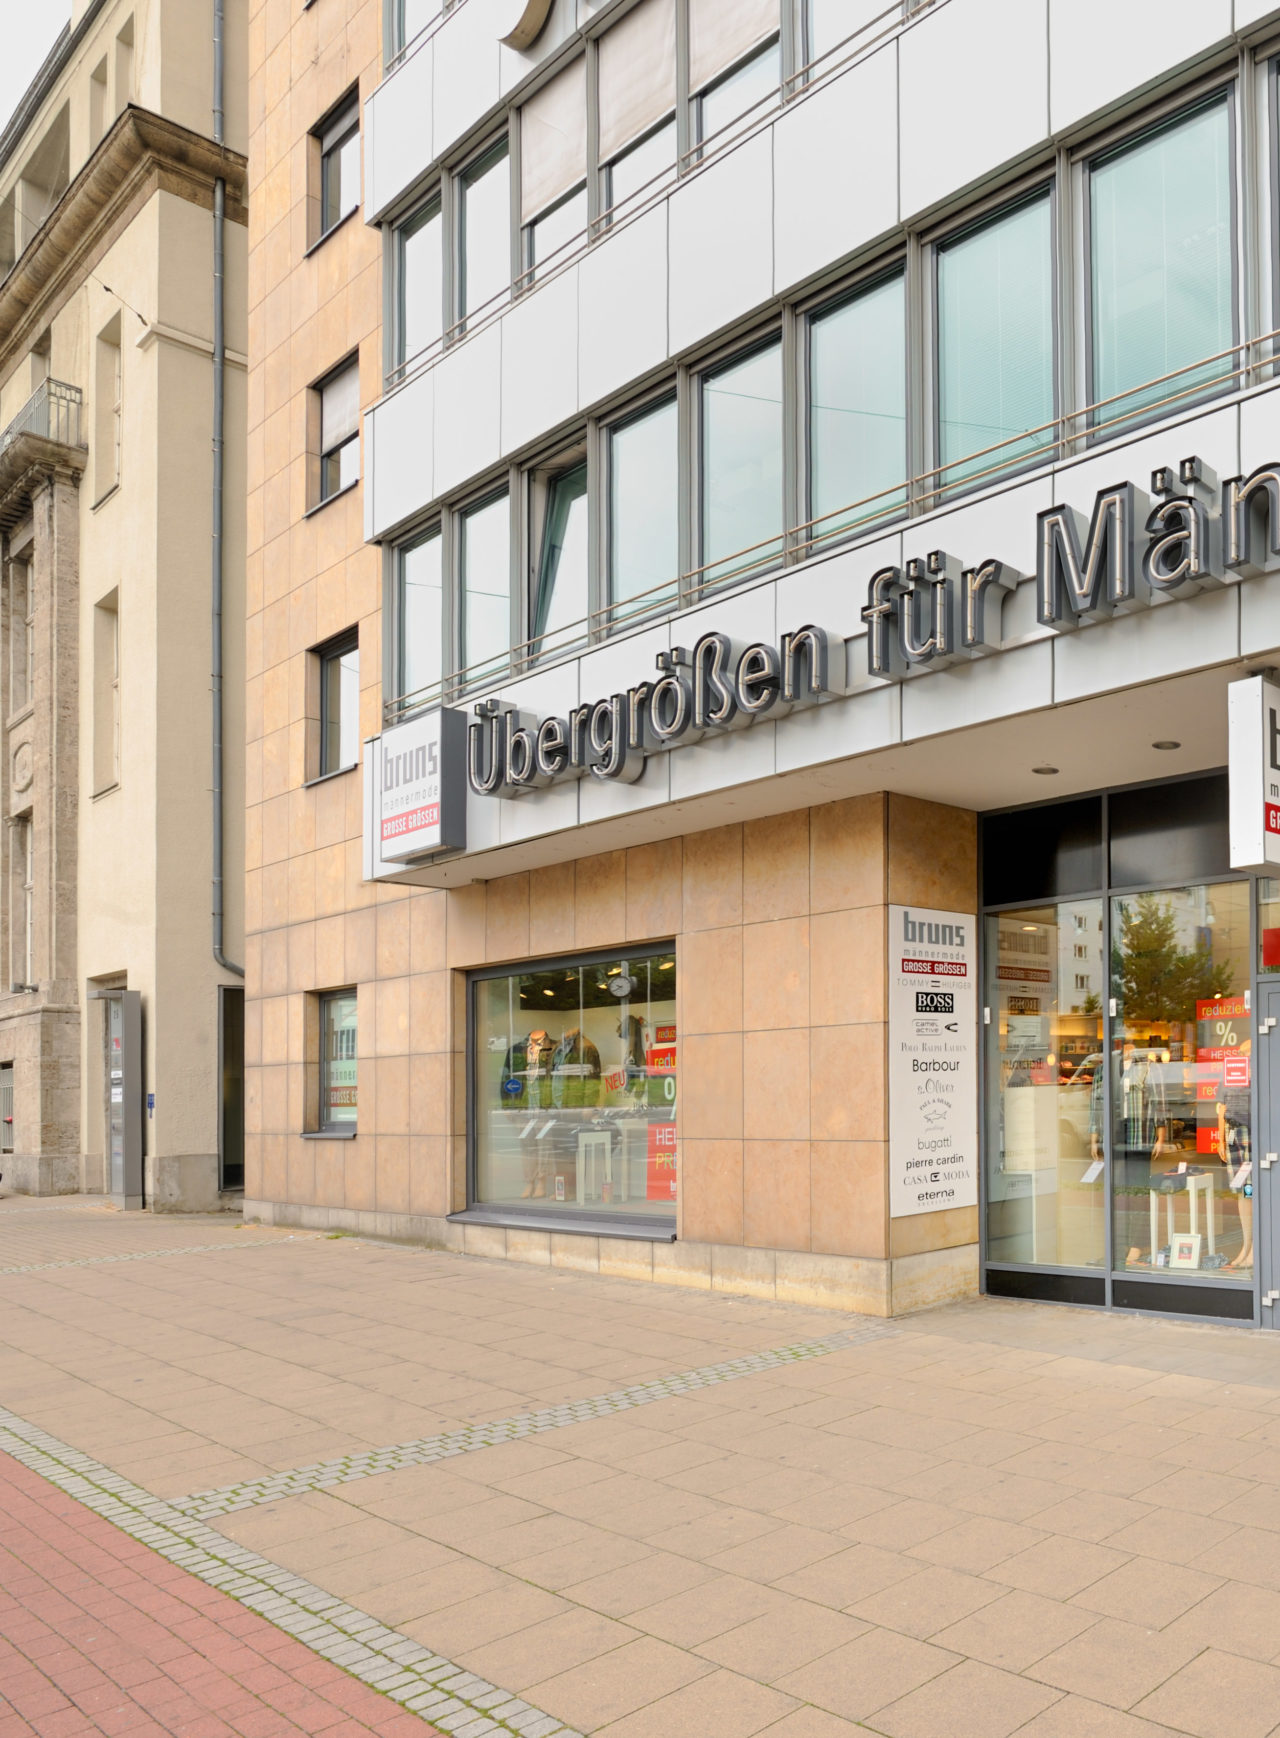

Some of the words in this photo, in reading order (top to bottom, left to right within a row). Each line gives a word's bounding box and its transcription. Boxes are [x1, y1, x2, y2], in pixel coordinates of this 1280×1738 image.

[467, 632, 832, 798] Übergrößen
[861, 551, 1016, 681] für
[384, 741, 438, 792] bruns
[383, 818, 407, 837] GROSSE
[408, 807, 438, 829] GRÖSSEN
[904, 911, 964, 947] bruns
[903, 961, 932, 973] GROSSE
[934, 962, 966, 975] GRÖSSEN
[897, 977, 929, 987] TOMMY
[918, 993, 953, 1007] BOSS
[912, 1059, 960, 1072] Barbour
[604, 1069, 626, 1093] NEU
[917, 1136, 952, 1152] bugatti
[906, 1158, 933, 1171] pierre
[936, 1154, 964, 1166] cardin
[903, 1176, 928, 1186] CASA
[943, 1170, 970, 1181] MODA
[917, 1189, 954, 1201] eterna
